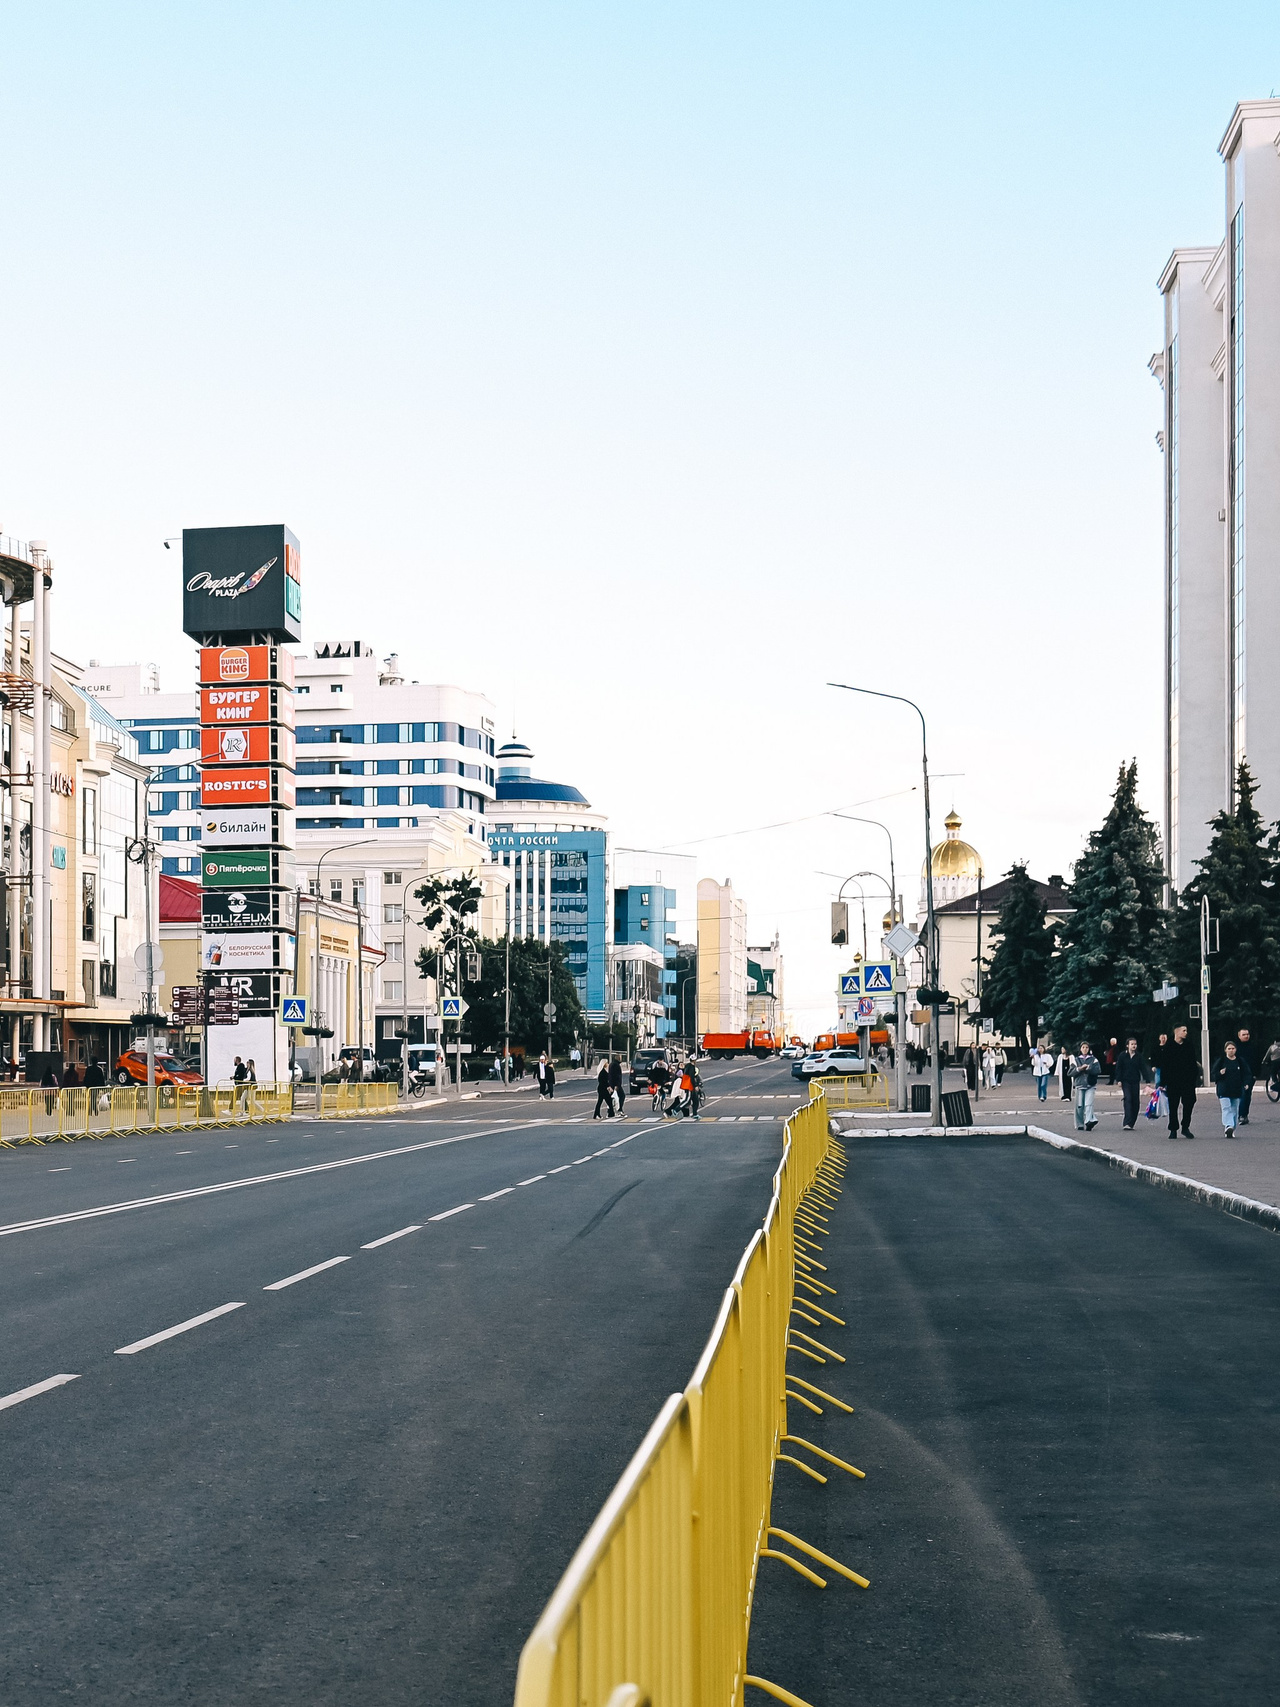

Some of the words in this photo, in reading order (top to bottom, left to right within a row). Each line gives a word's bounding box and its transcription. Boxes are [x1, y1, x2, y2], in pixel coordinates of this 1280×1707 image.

[215, 588, 239, 598] PLAZA
[221, 664, 247, 674] KING
[209, 690, 260, 704] БУРГЕР
[216, 706, 253, 719] КИНГ
[204, 780, 267, 791] ROSTIC'S
[220, 821, 266, 833] билайн
[519, 836, 558, 845] РОССИИ
[219, 865, 267, 873] Пятёрочка
